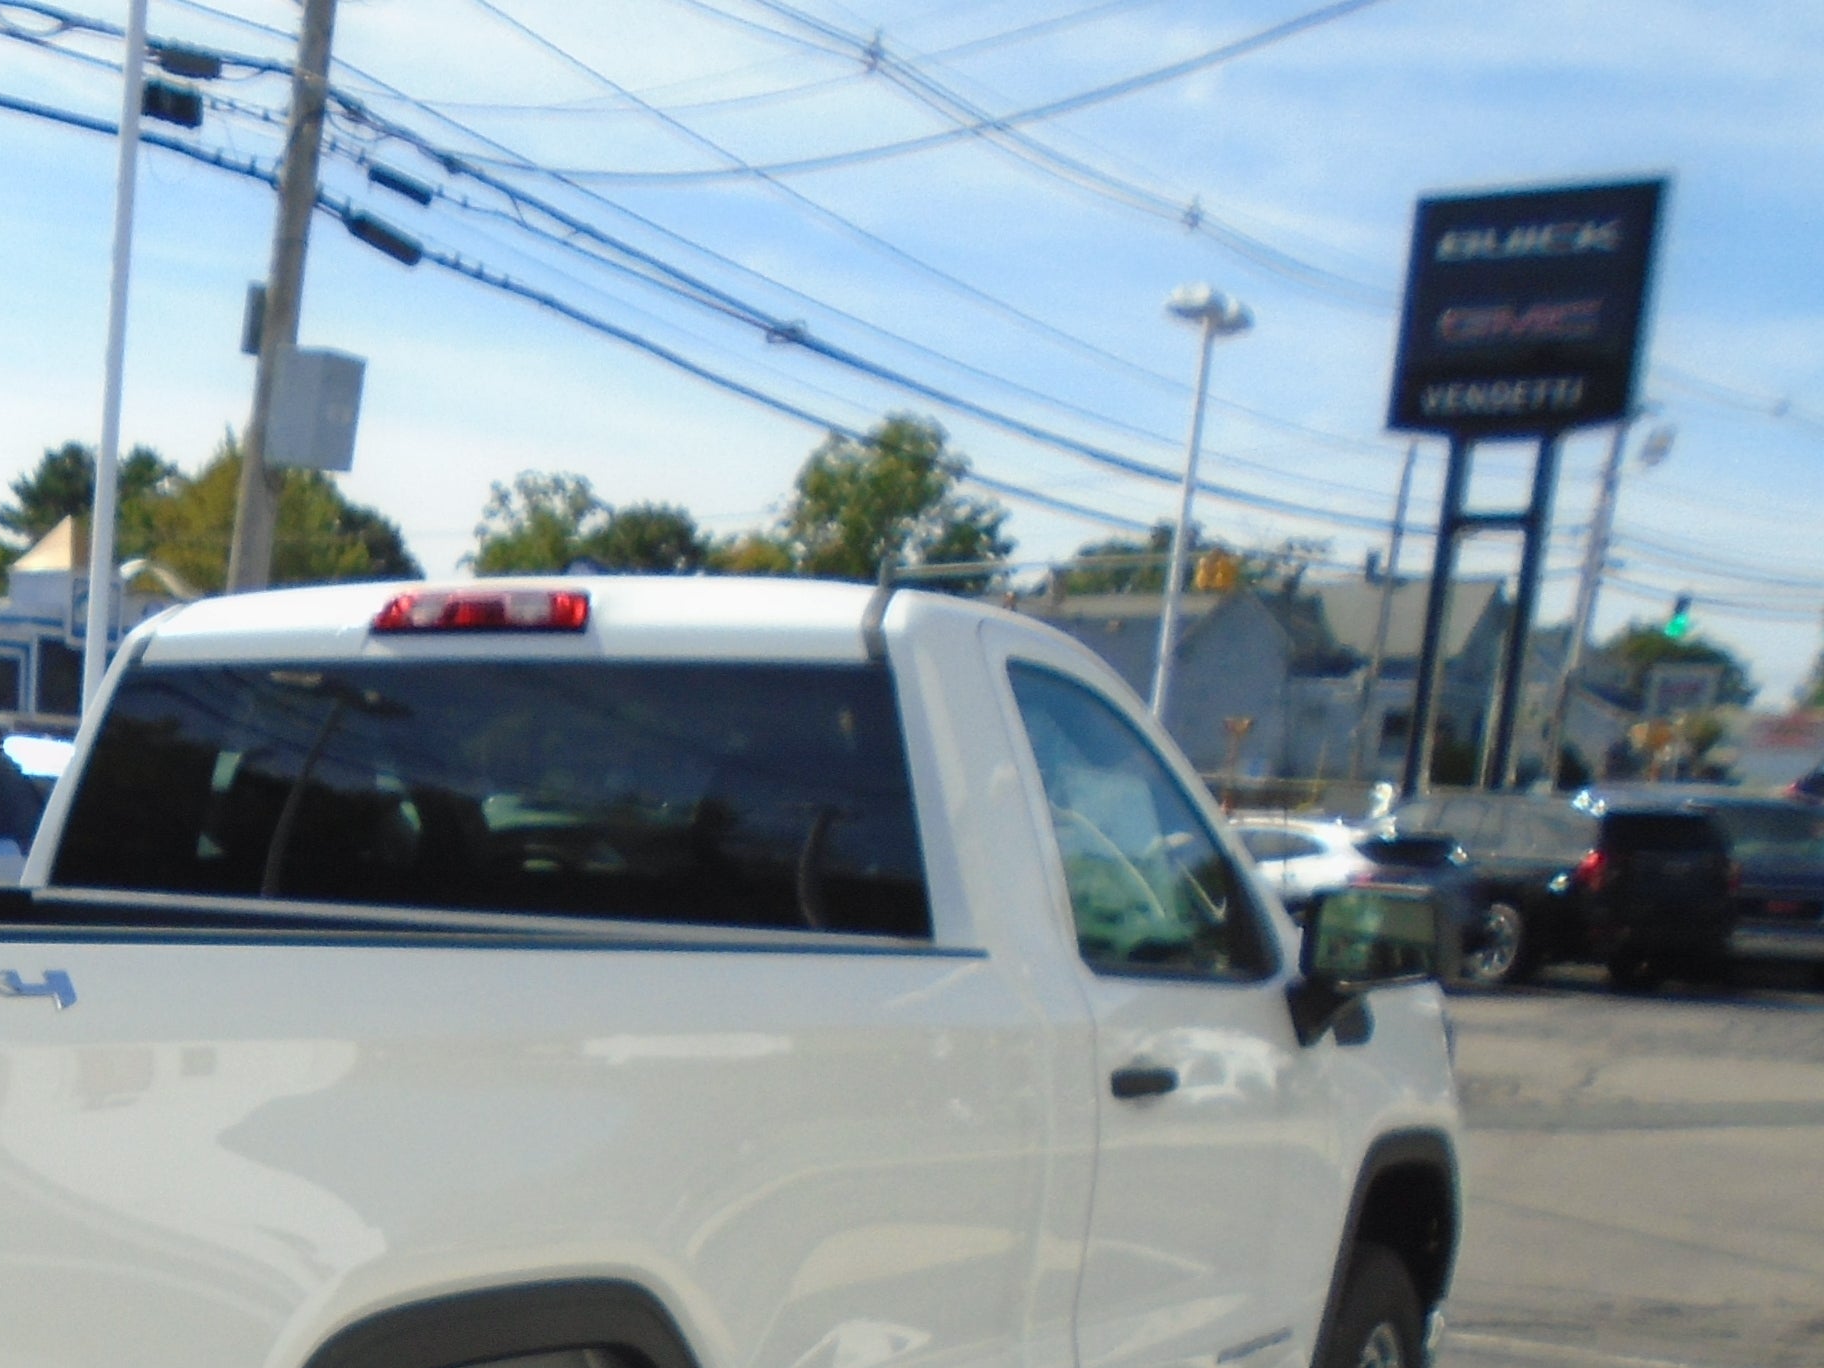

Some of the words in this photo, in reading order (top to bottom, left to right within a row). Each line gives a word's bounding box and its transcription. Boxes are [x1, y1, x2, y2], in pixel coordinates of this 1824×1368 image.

[1434, 220, 1622, 262] BUICK
[1438, 300, 1604, 341] GMC
[1420, 377, 1584, 416] VENDETTI
